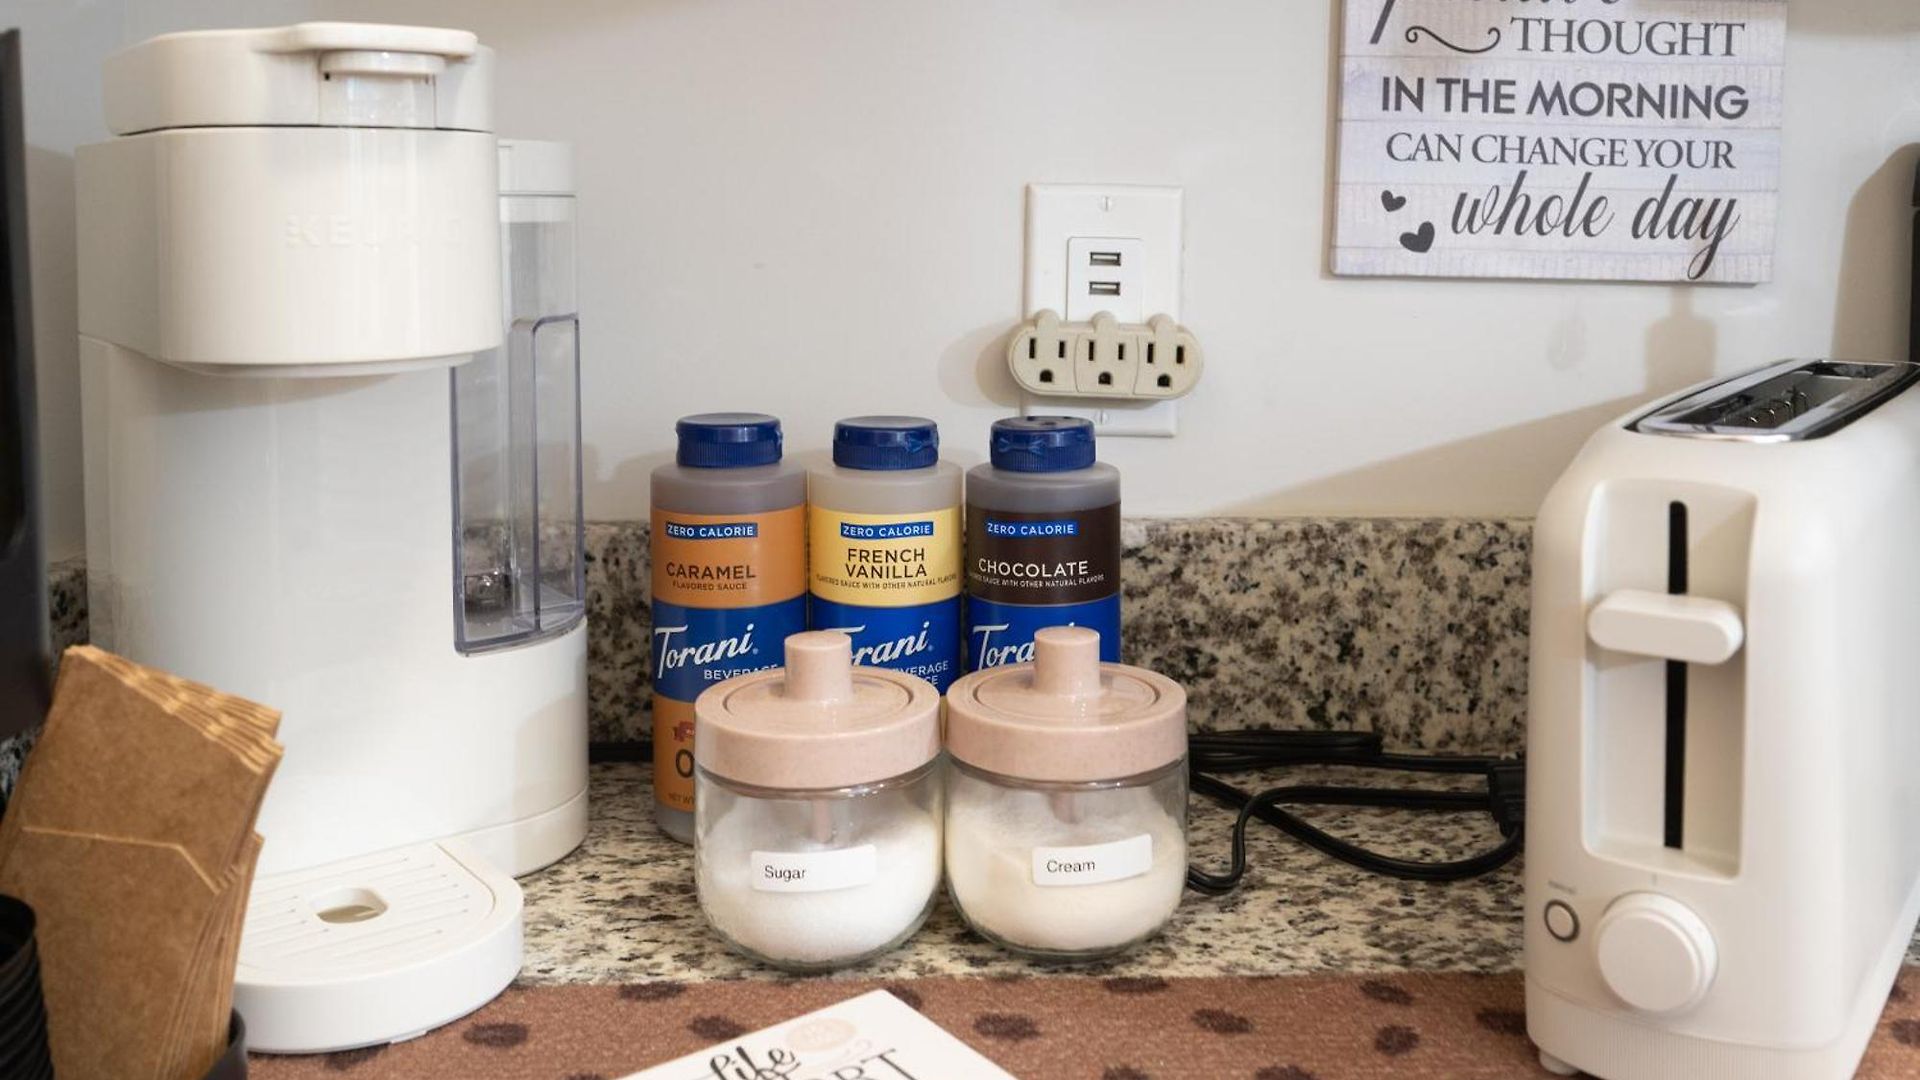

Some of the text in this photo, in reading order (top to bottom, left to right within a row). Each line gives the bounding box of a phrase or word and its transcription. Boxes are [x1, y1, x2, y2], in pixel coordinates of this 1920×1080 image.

[1510, 16, 1746, 57] THOUGHT
[1382, 75, 1749, 120] IN THE MORNING
[1386, 132, 1736, 169] CAN CHANGE YOUR
[1451, 169, 1741, 280] whole day
[667, 524, 754, 537] ZERO CALORIE
[842, 524, 931, 537] ZERO CALORIE
[987, 523, 1075, 535] ZERO CALORIE
[847, 548, 925, 564] FRENCH
[666, 561, 757, 580] CARAMEL
[844, 563, 928, 579] VANILLA
[978, 558, 1089, 578] CHOCOLATE
[672, 580, 747, 591] FLAVORED SAUCE
[1045, 578, 1077, 588] NATURAL
[654, 623, 754, 679] Torani
[824, 621, 929, 666] rani
[973, 622, 1075, 670] Tora
[704, 664, 778, 679] BEVE
[893, 660, 949, 676] VERAGE
[764, 864, 806, 883] Sugar
[1046, 859, 1096, 873] Cream
